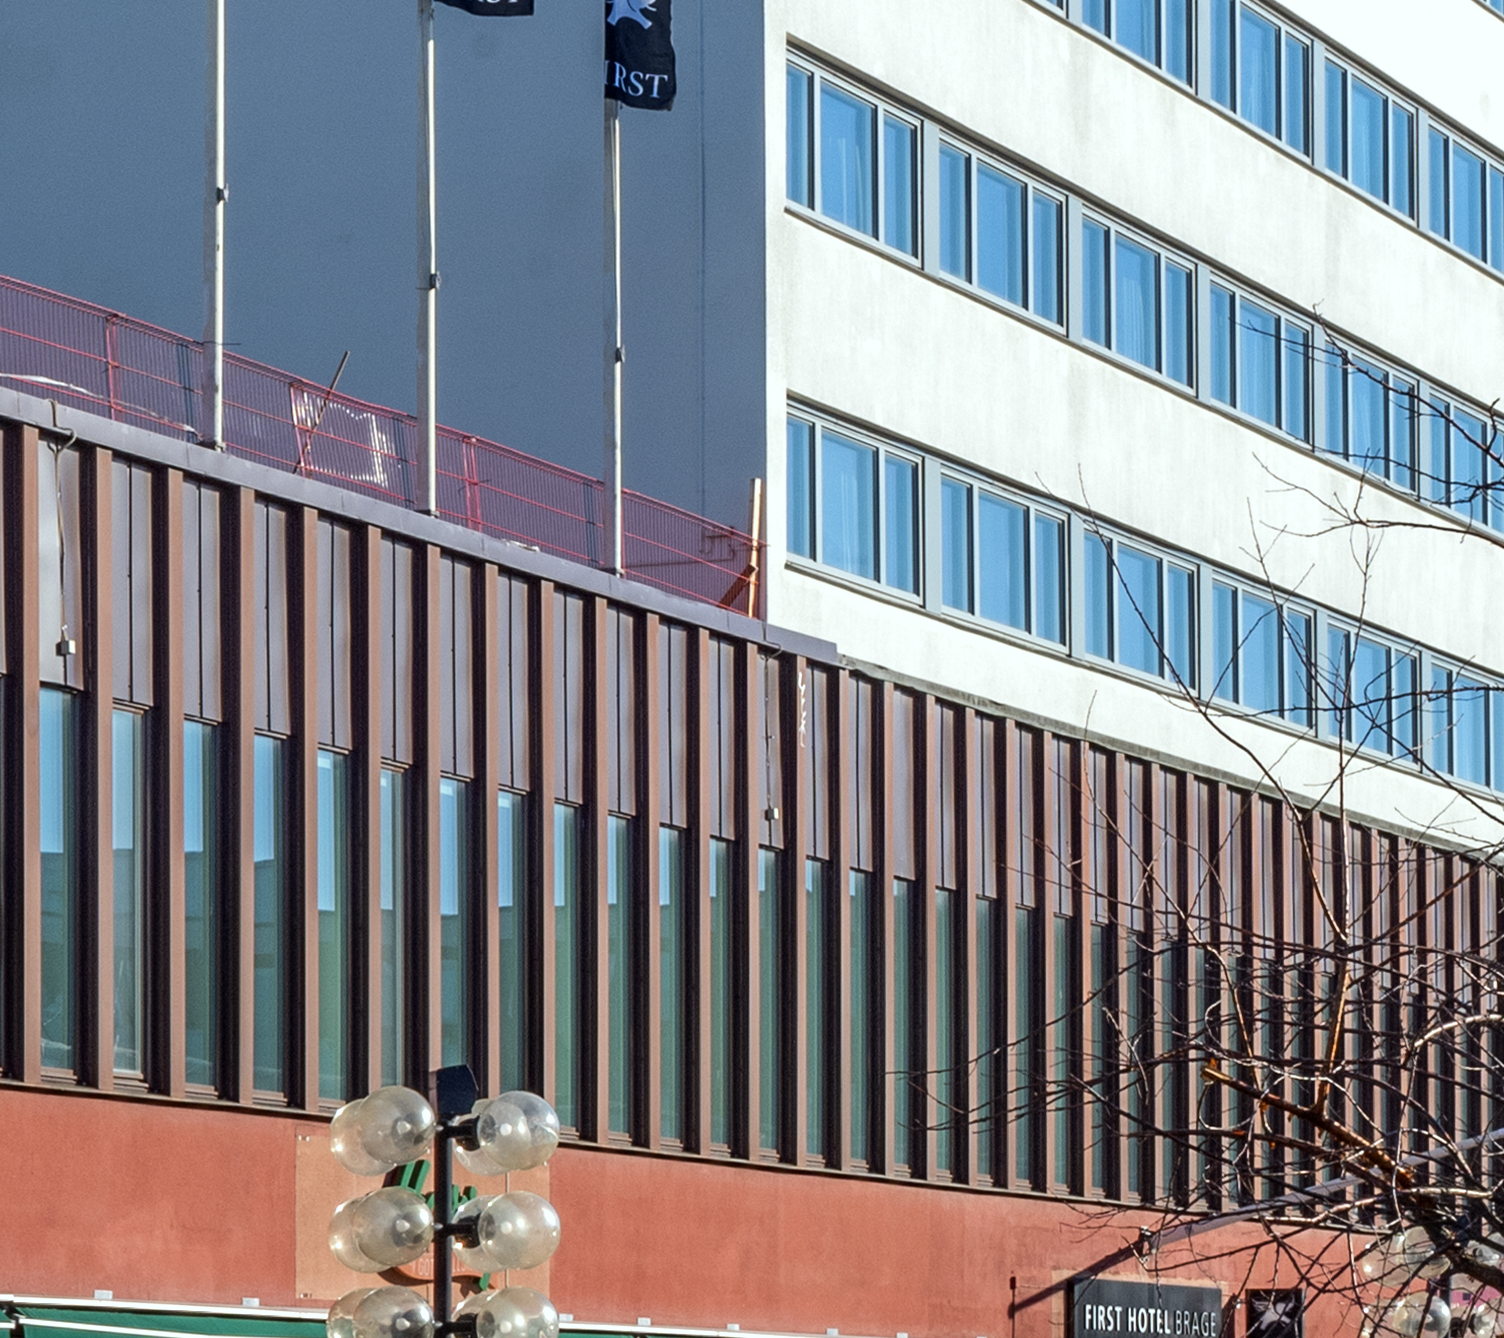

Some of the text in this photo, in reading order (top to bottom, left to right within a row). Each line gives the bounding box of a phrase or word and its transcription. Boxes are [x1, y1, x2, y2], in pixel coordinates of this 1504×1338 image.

[604, 60, 669, 99] IRST
[1085, 1304, 1217, 1337] FIRST HOTEL BRAGE
